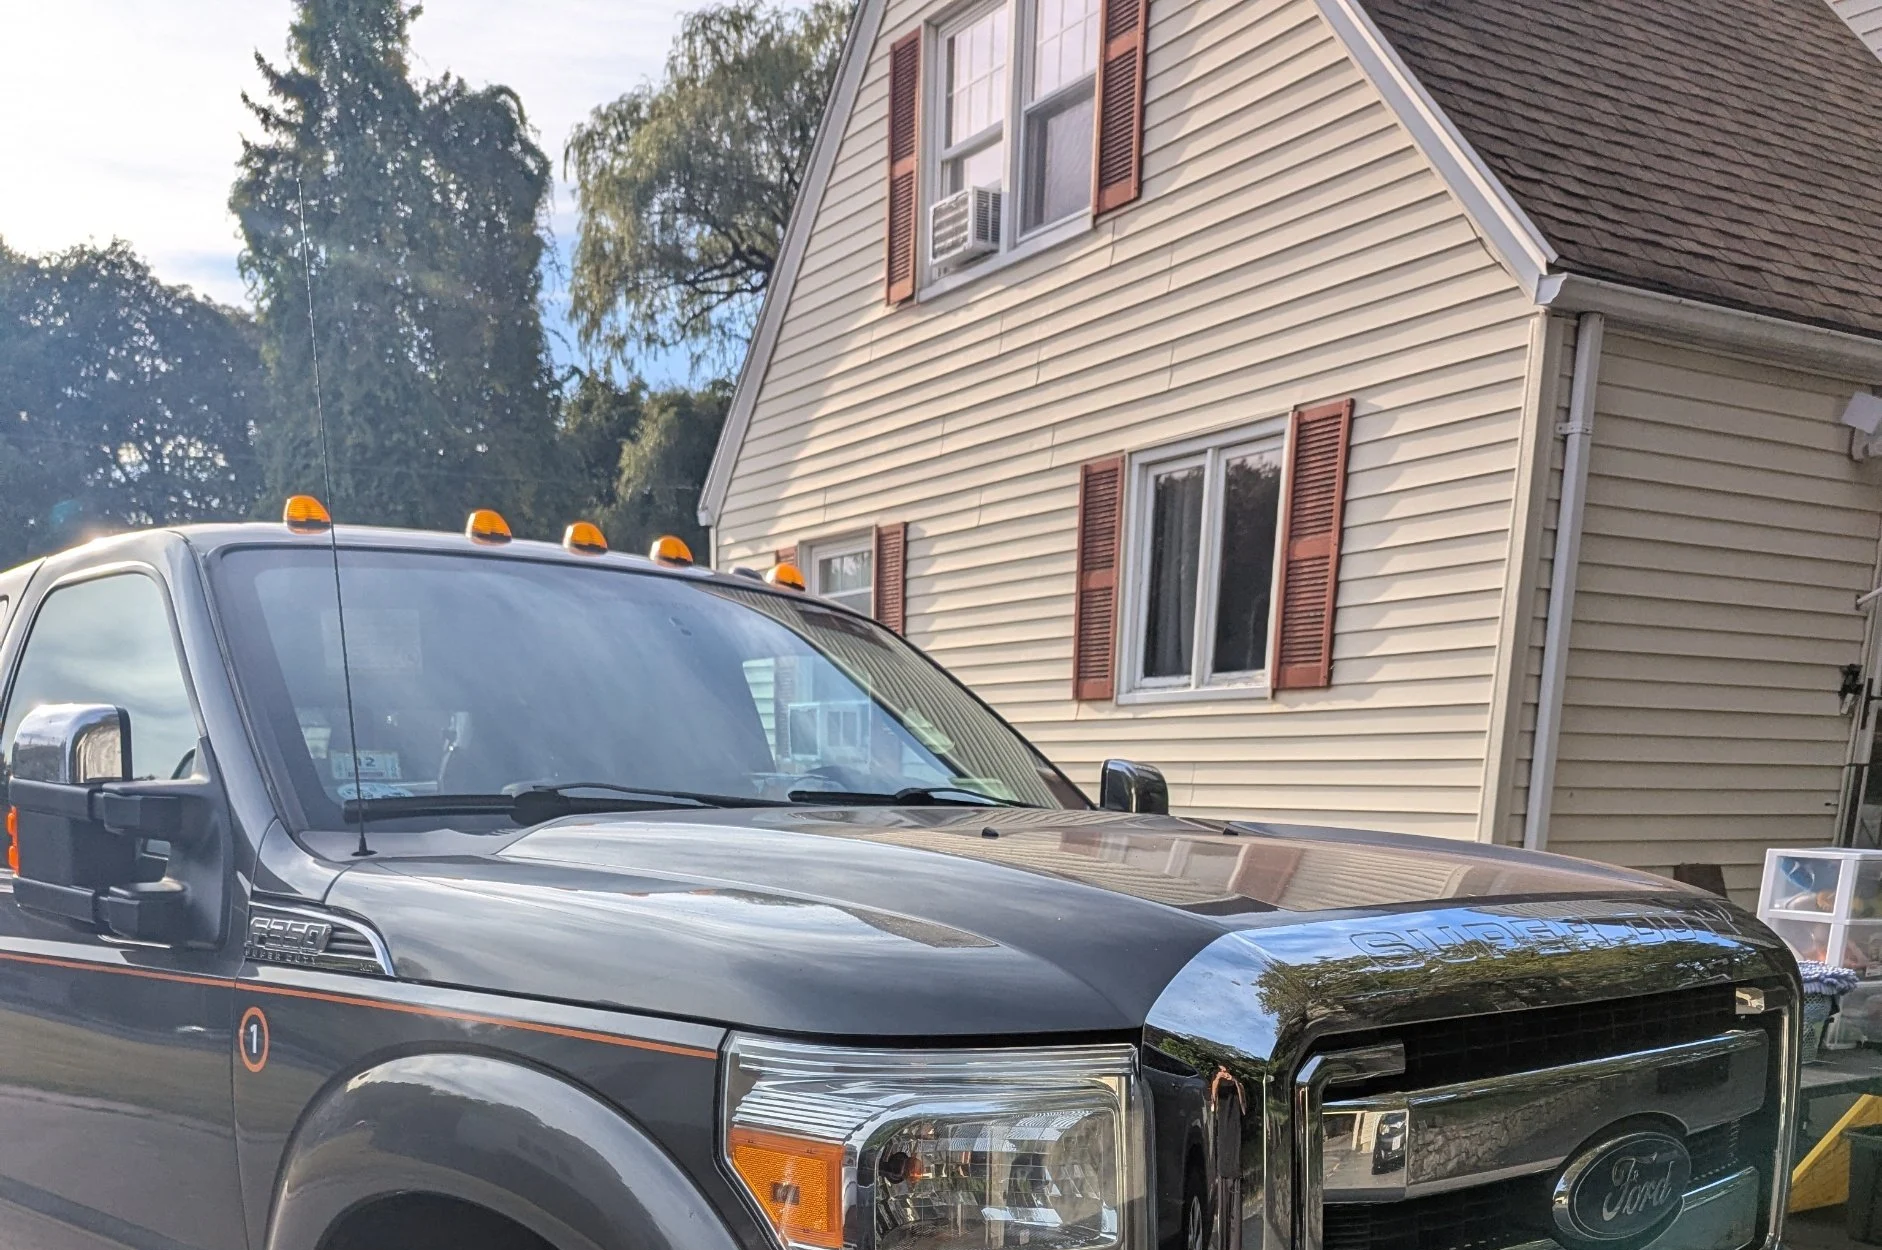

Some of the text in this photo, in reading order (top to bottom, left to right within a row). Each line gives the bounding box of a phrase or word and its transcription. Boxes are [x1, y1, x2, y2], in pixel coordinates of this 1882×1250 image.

[1350, 914, 1612, 970] SUPER
[250, 1023, 258, 1054] 1
[1602, 1151, 1678, 1222] Ford
